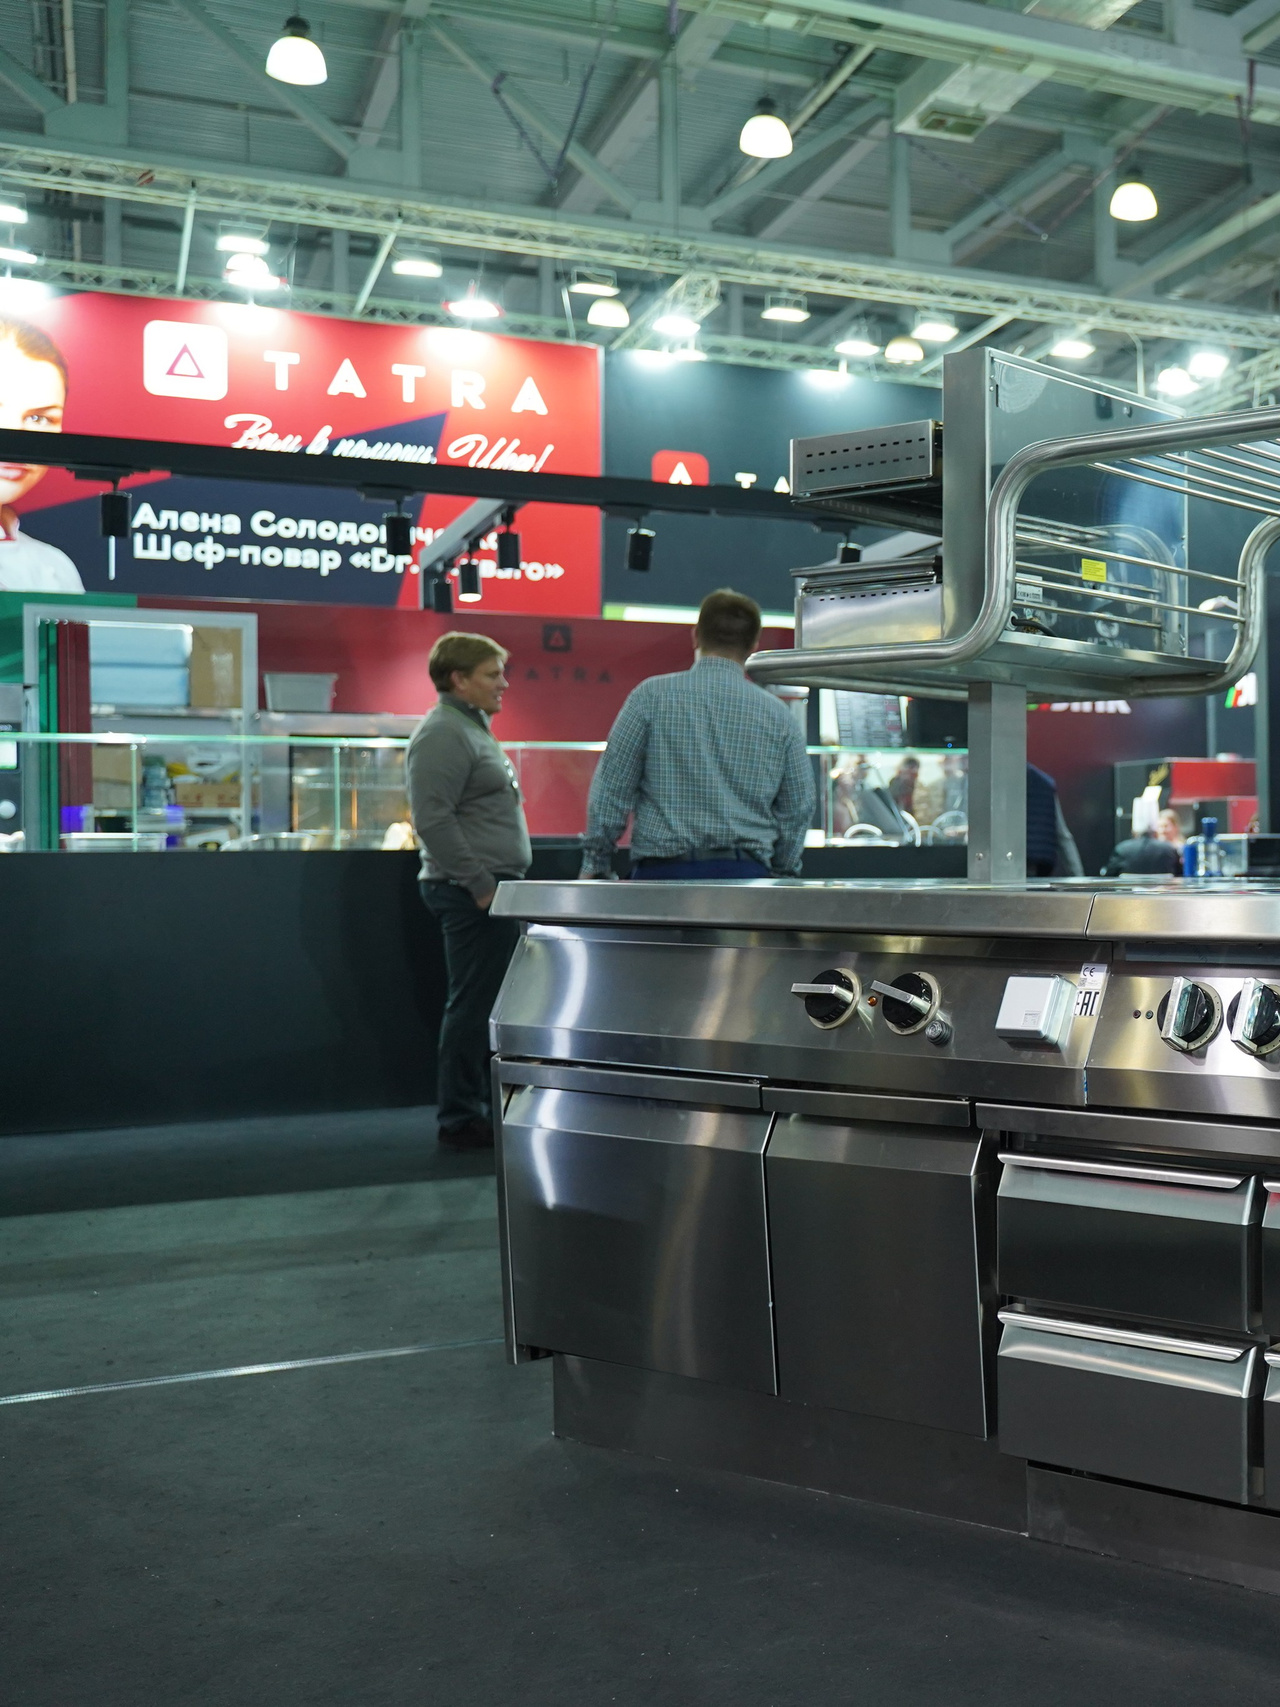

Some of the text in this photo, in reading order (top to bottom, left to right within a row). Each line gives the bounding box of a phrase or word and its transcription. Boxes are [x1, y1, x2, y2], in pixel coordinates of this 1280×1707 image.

[262, 350, 549, 416] TATRA
[130, 502, 242, 535] Алена
[132, 533, 342, 577] Шеф-повар
